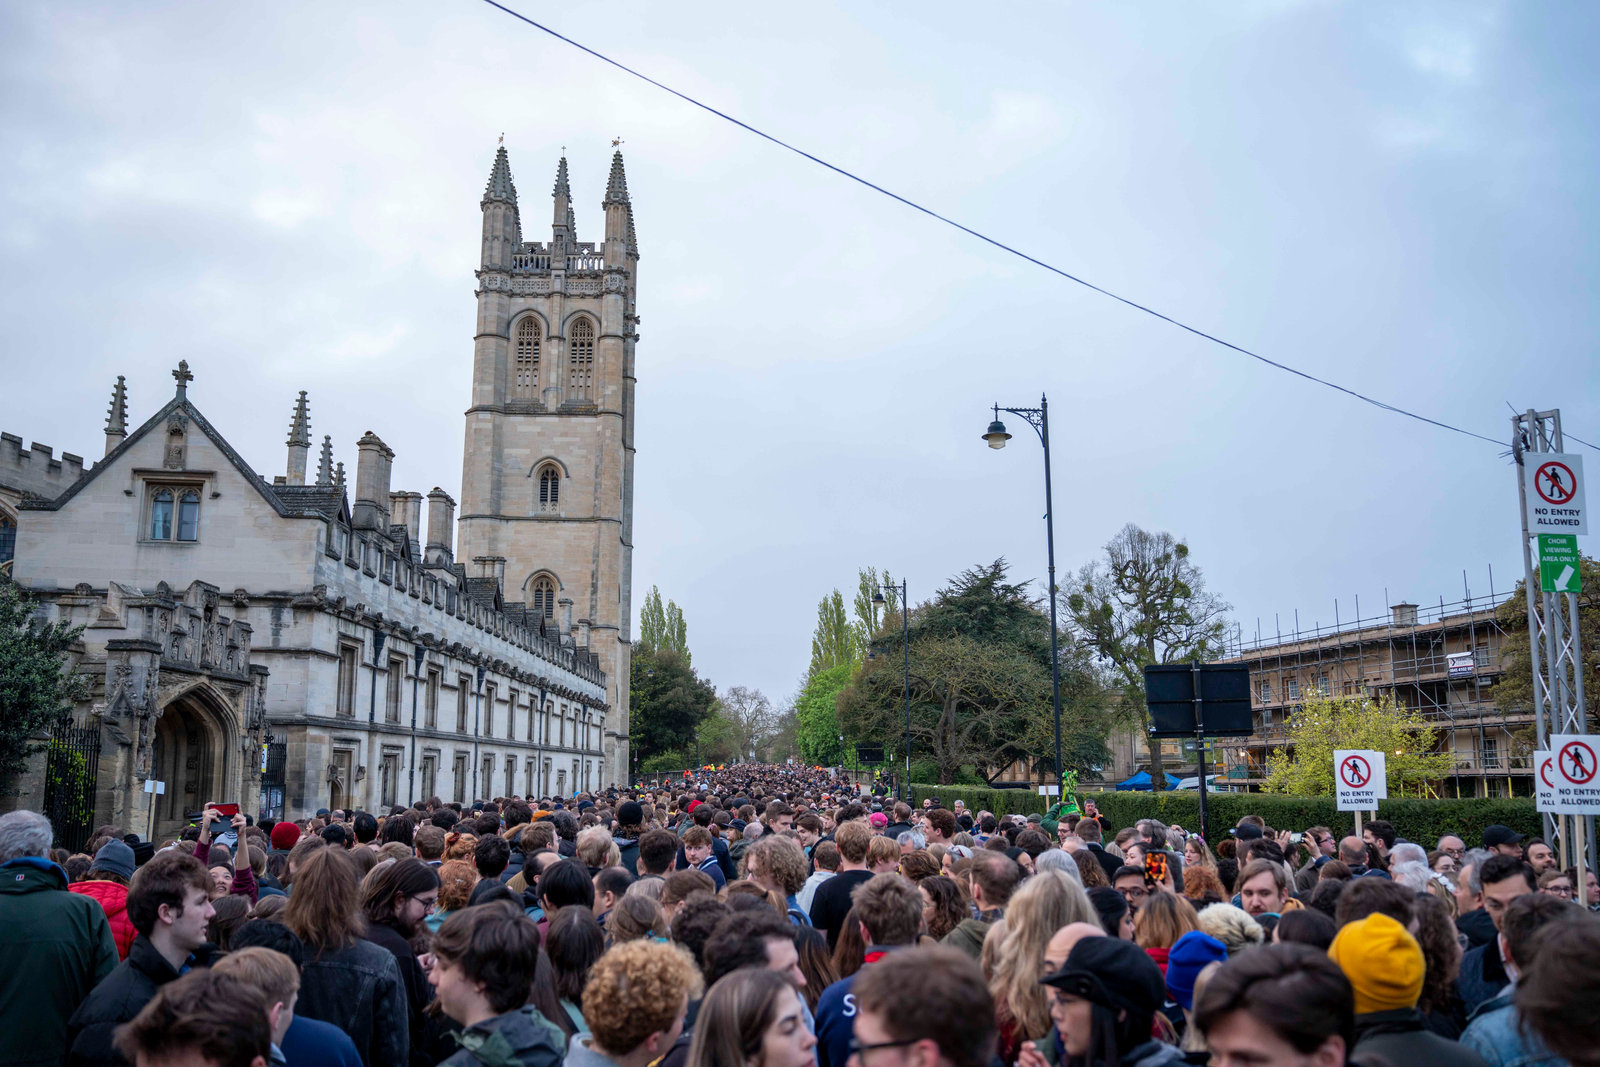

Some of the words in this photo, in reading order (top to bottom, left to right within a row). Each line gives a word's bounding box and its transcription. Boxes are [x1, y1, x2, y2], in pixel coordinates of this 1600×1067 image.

[1551, 508, 1580, 516] ENTRY
[1537, 518, 1580, 526] ALLOWED
[1574, 788, 1600, 796] ENTRY
[1560, 798, 1600, 806] ALLOWED
